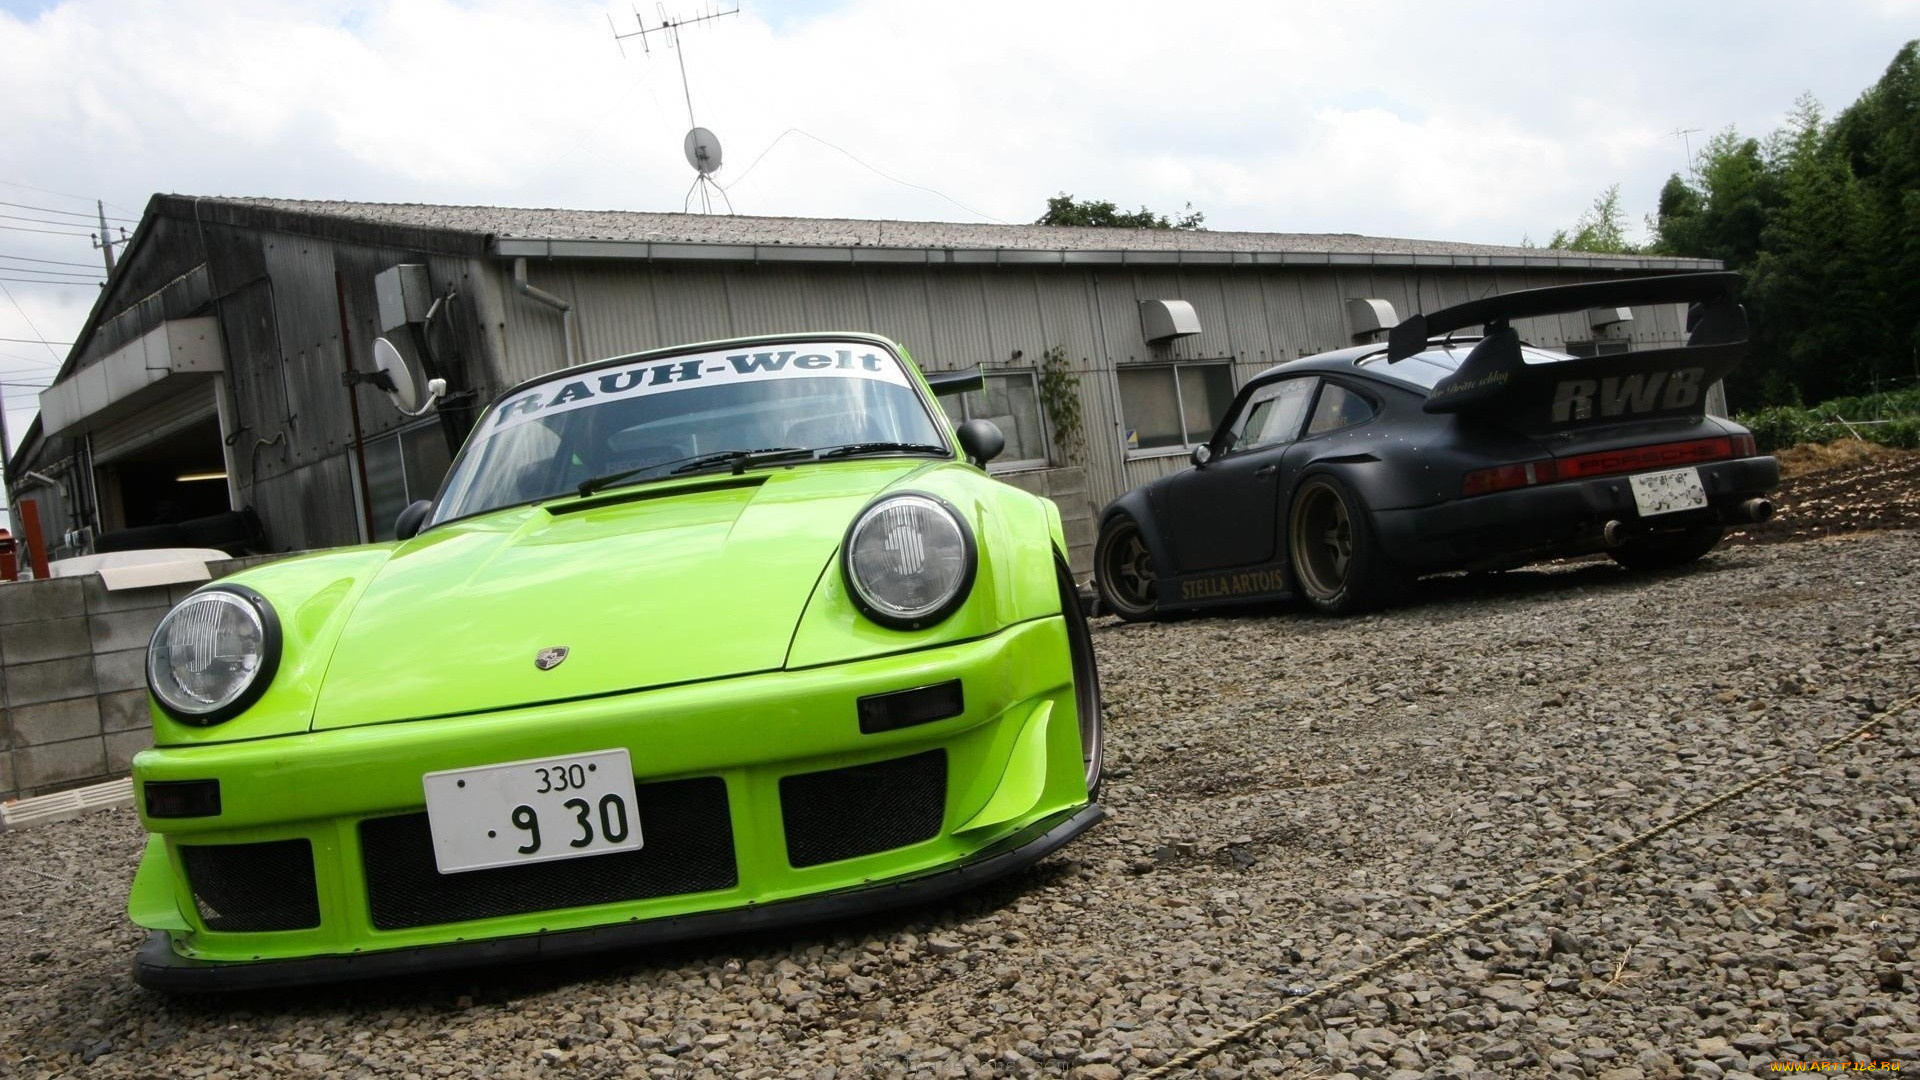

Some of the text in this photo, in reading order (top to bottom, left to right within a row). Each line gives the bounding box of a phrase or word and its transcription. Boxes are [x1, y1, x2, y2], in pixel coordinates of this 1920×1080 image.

[494, 349, 883, 427] RAUH-Welt
[1551, 367, 1706, 423] RWB
[1579, 445, 1716, 474] PORSCHE
[1181, 569, 1283, 600] STELLA ARTOIS
[535, 763, 586, 794] 330
